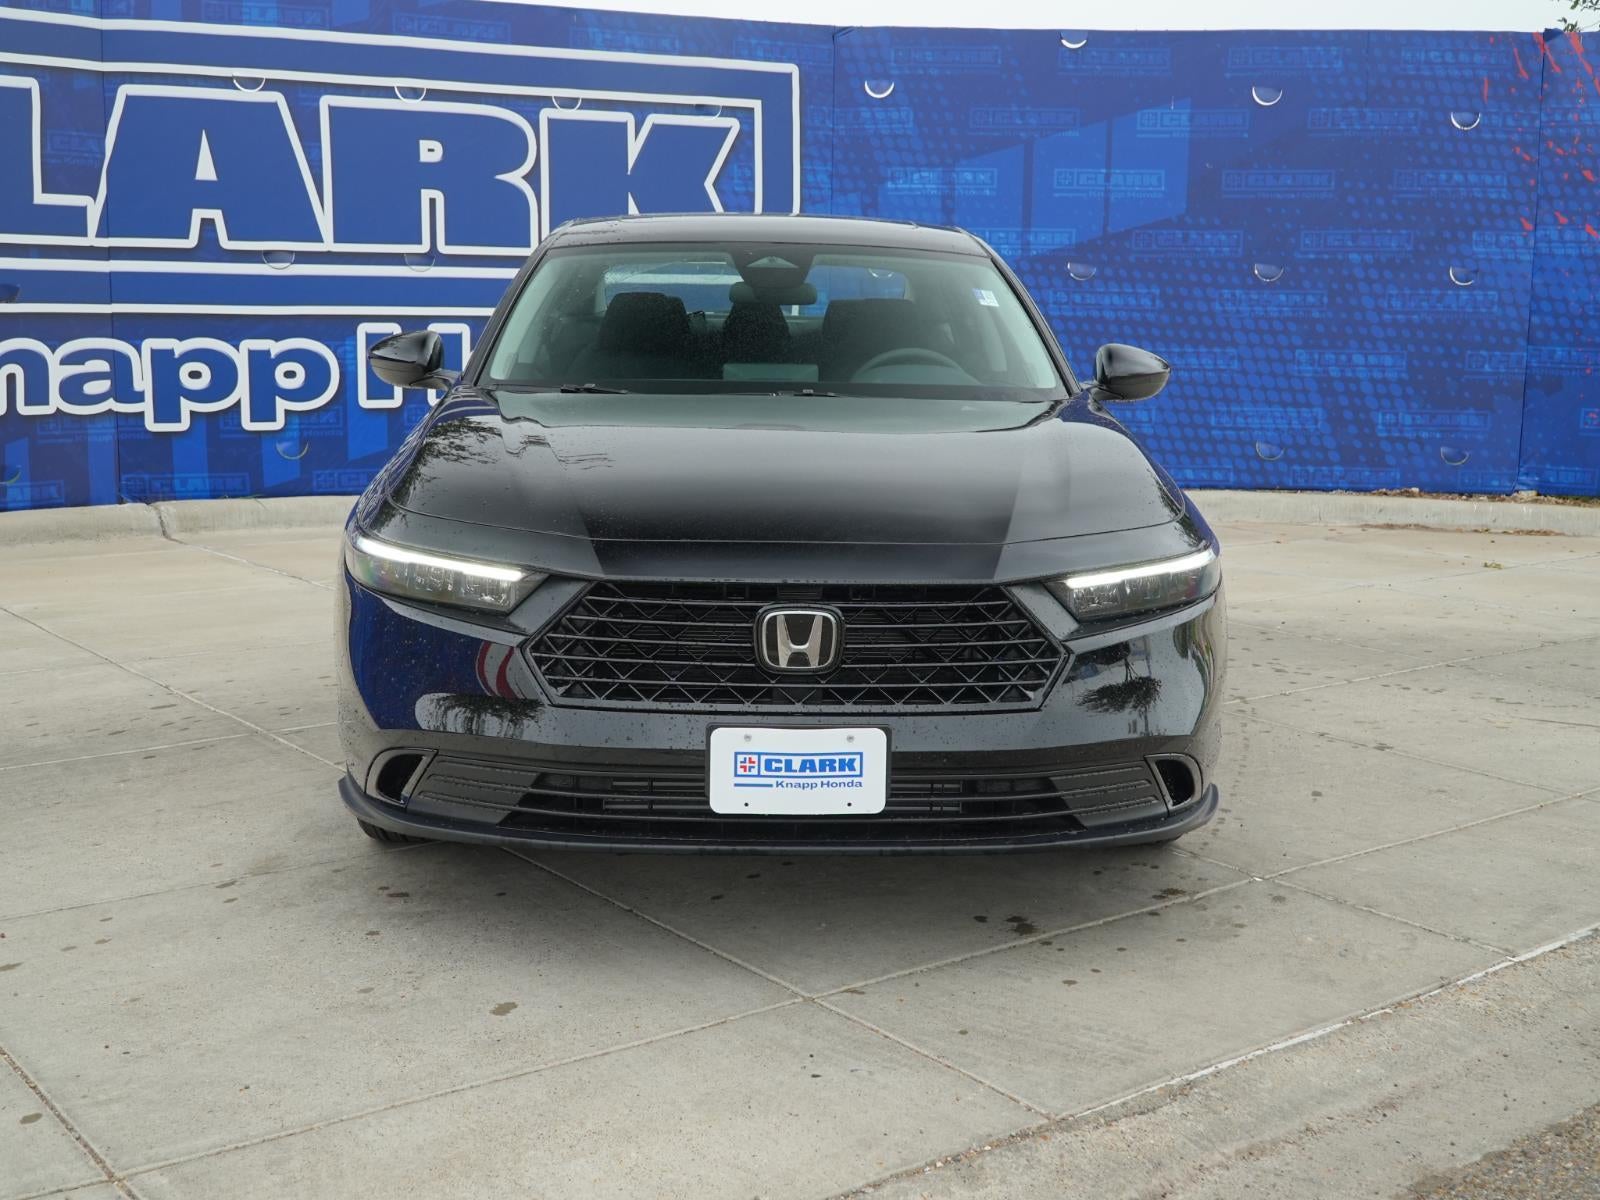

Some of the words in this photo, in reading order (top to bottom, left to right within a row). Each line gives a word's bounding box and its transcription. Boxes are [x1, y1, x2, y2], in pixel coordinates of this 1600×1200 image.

[764, 758, 857, 773] CLARK
[775, 780, 818, 790] Knapp
[820, 780, 863, 788] Honda
